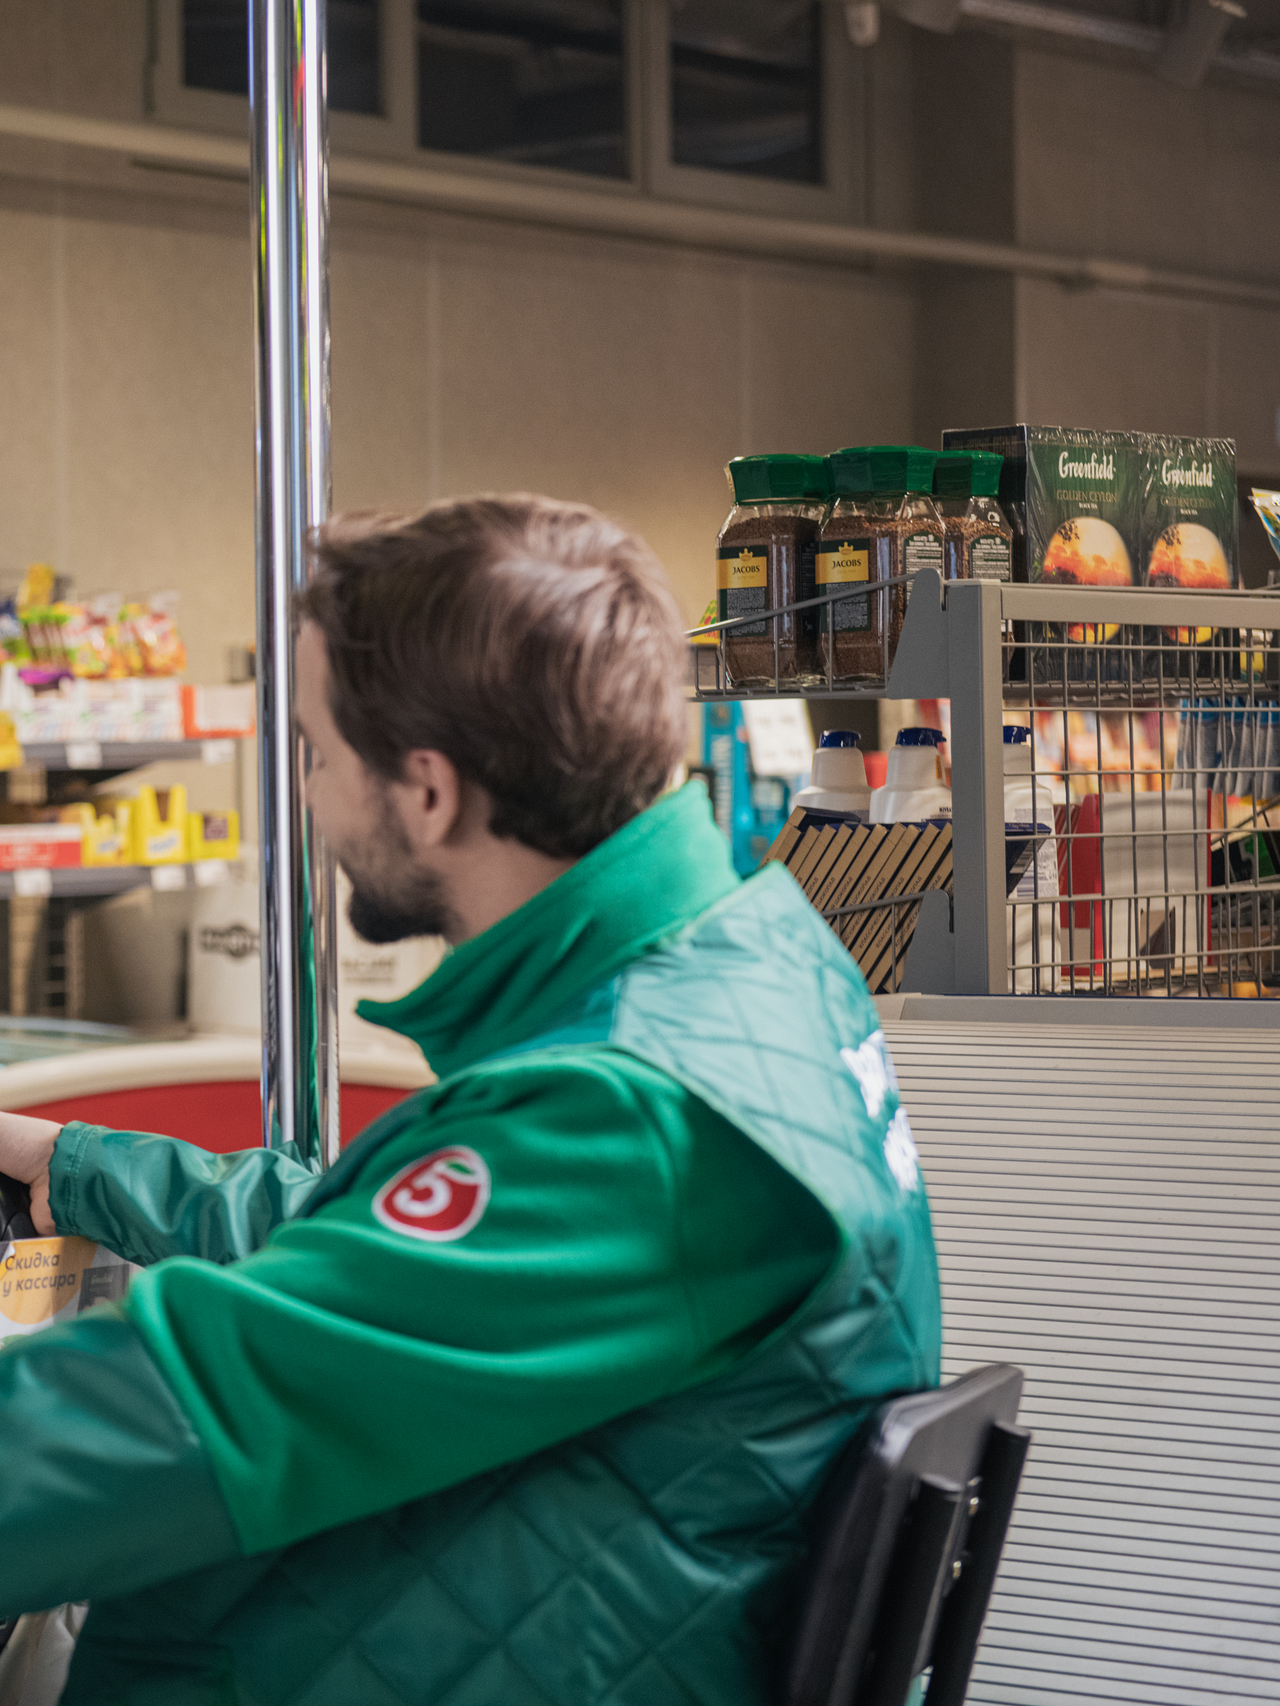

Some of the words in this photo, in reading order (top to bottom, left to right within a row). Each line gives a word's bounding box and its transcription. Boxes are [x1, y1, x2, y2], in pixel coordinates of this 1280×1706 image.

[1058, 451, 1114, 481] Greenfield
[1161, 458, 1213, 488] Greenfield
[1057, 489, 1088, 502] GOLDEN
[732, 564, 761, 576] JACOBS
[832, 558, 862, 570] JACOBS
[392, 1159, 477, 1218] 5
[5, 1252, 61, 1272] Скидка
[2, 1280, 12, 1298] у
[15, 1273, 76, 1292] кассира
